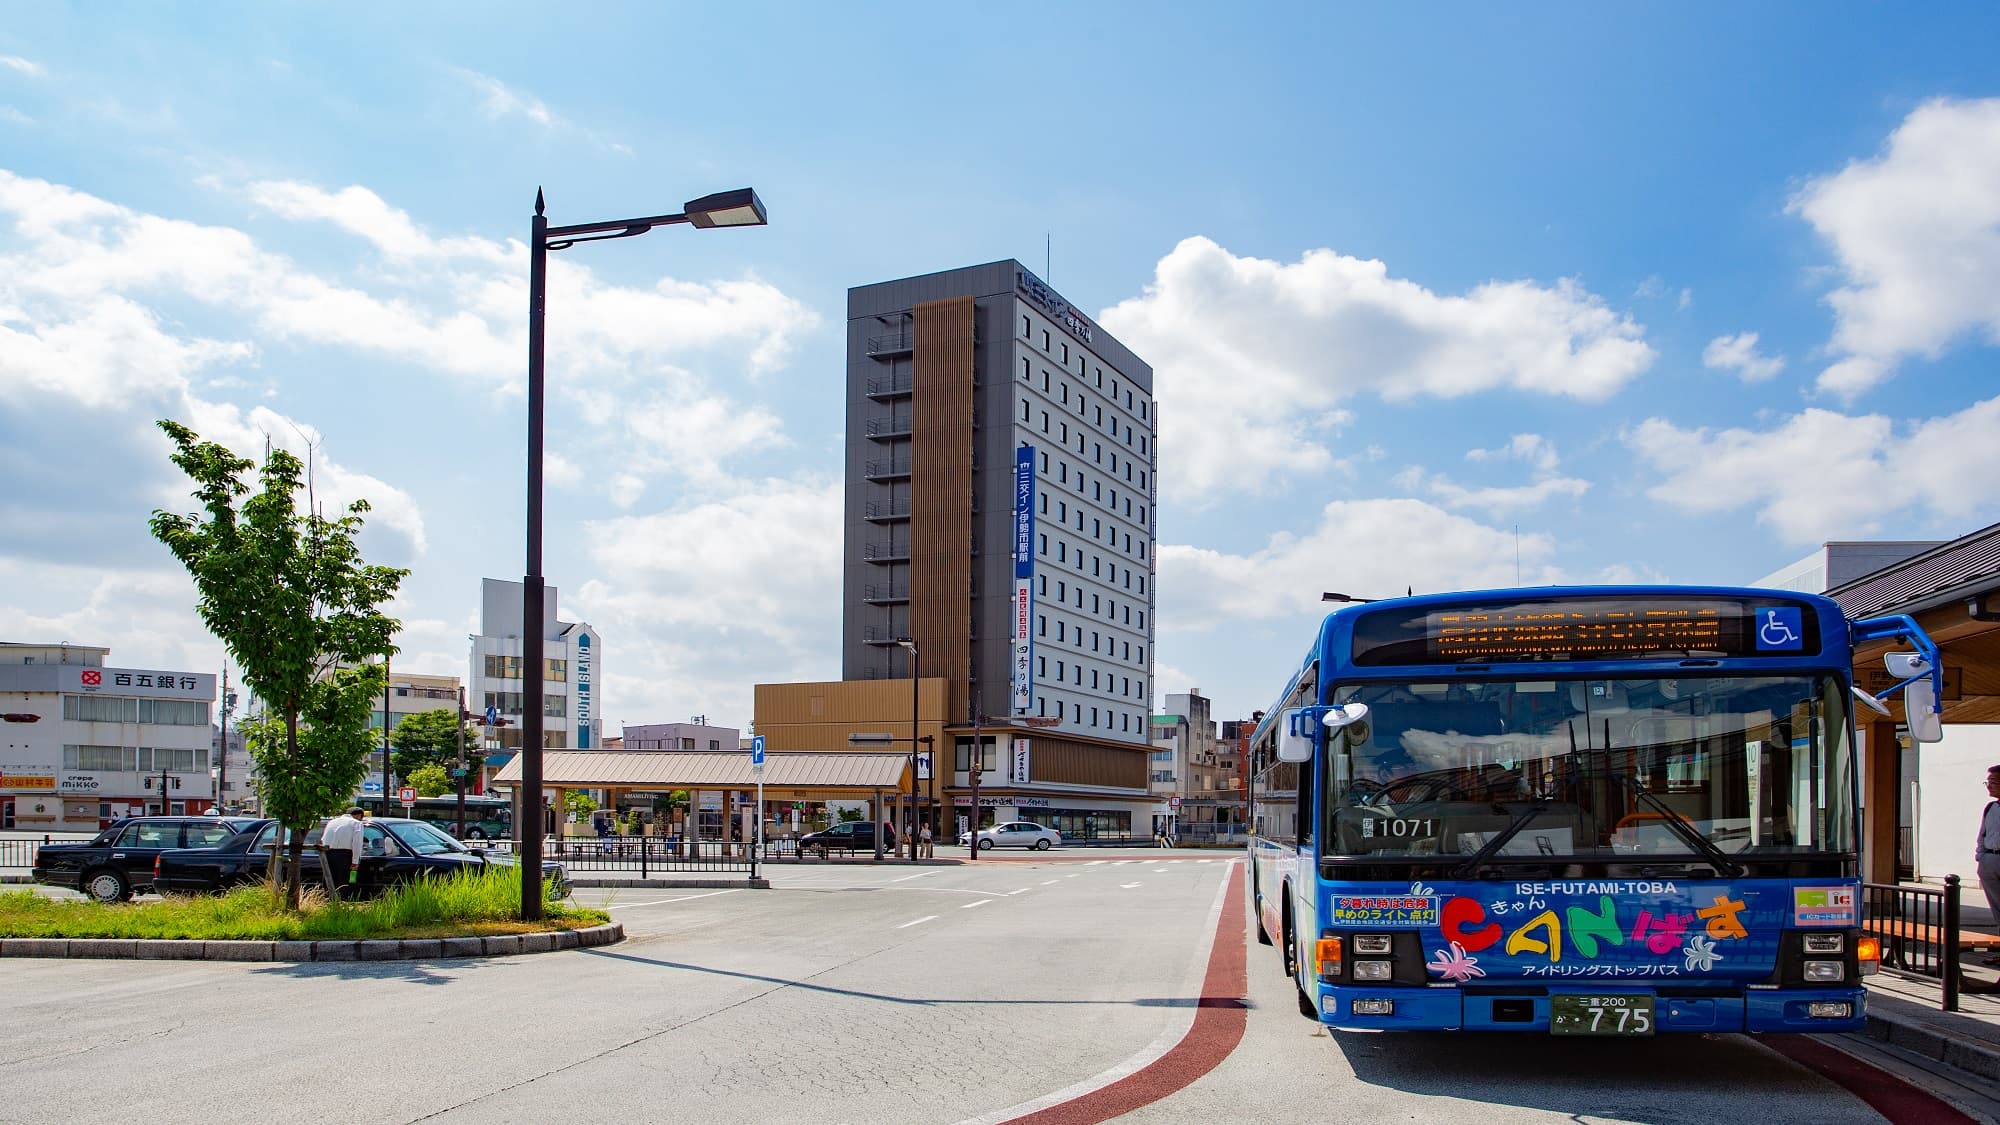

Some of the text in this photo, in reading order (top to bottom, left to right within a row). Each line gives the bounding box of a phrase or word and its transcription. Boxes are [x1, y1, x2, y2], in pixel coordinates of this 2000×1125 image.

[114, 673, 197, 690] 百五銀行
[578, 646, 591, 727] SOUTH ISLAND
[755, 740, 762, 761] P
[1379, 819, 1433, 837] 1071
[1515, 882, 1678, 895] ISE-FUTAMI-TOBA
[1340, 898, 1429, 909] 夕暮れ時は危険
[1490, 896, 1546, 915] きゃん
[1522, 965, 1679, 976] アイドリングストップバス
